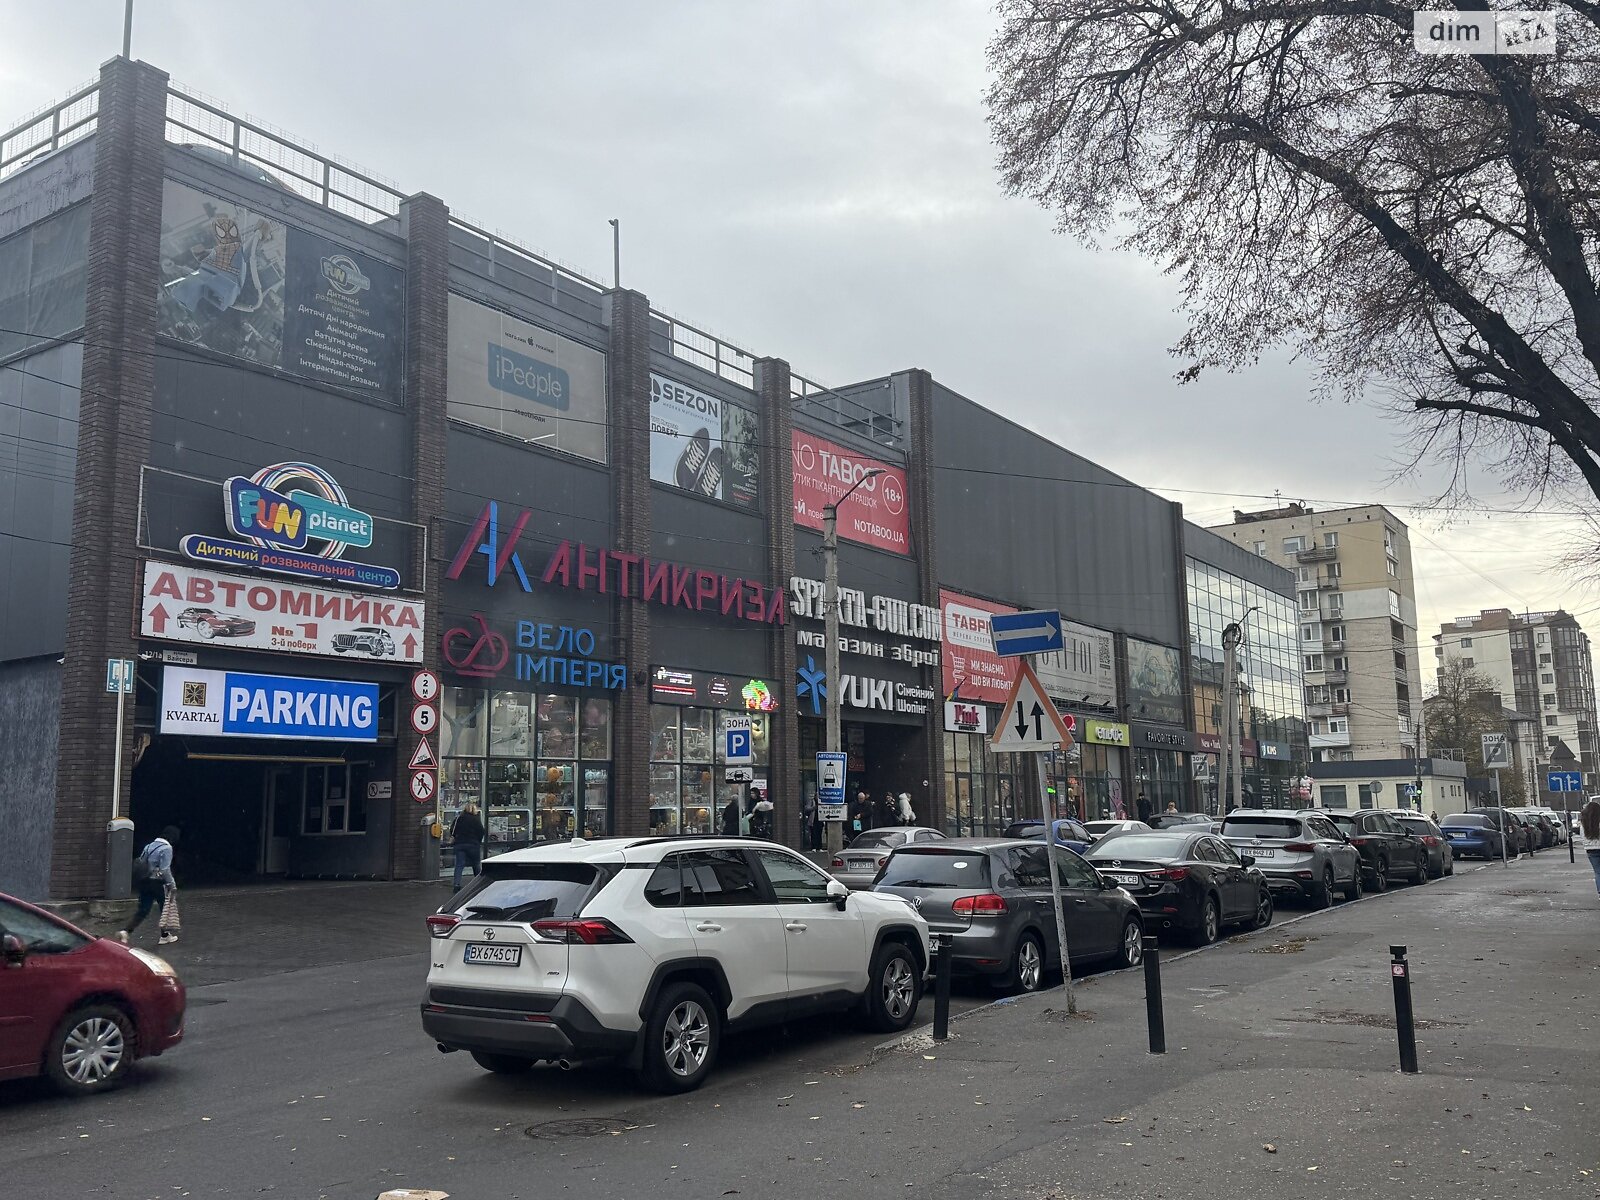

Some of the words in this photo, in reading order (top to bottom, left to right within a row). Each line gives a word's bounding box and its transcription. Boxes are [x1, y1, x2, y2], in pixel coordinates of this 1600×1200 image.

[298, 304, 325, 319] Дитячі
[326, 313, 339, 323] Дні
[339, 319, 385, 340] народження
[326, 324, 358, 340] Анімації
[314, 330, 346, 346] Батутна
[346, 342, 368, 354] арена
[318, 352, 364, 373] Ніндзя-парк
[342, 351, 377, 367] ресторан
[299, 357, 350, 379] Інтерактивні
[350, 375, 380, 389] розваги
[495, 353, 562, 398] iPeople
[662, 382, 719, 418] SEZON
[884, 487, 902, 503] 18+
[237, 489, 302, 540] FUN
[309, 511, 368, 537] planet
[853, 518, 905, 545] NOTABOO.UA
[196, 541, 259, 562] Дитячий
[261, 552, 356, 577] розважальний
[357, 568, 393, 584] центр
[542, 538, 785, 626] АНТИКРИЗА
[149, 571, 421, 629] АВТОМИЙКА
[270, 637, 286, 648] 3-й
[286, 639, 318, 651] поверх
[516, 619, 596, 657] ВЕЛО
[796, 629, 884, 658] маазин
[890, 642, 939, 668] зброї
[516, 653, 628, 690] ІМПЕРІЯ
[970, 658, 981, 671] МИ
[422, 679, 429, 687] 2
[896, 681, 936, 700] Сімейний
[971, 674, 982, 687] ЩО
[982, 677, 992, 688] ВИ
[165, 710, 220, 723] KVARTAL
[229, 686, 373, 729] PARKING
[895, 698, 928, 715] Шопінг
[420, 710, 429, 725] 5
[726, 717, 750, 729] ЗОНА
[732, 734, 745, 754] P
[469, 946, 484, 960] BX
[483, 947, 504, 962] 6745
[504, 948, 519, 962] CT
